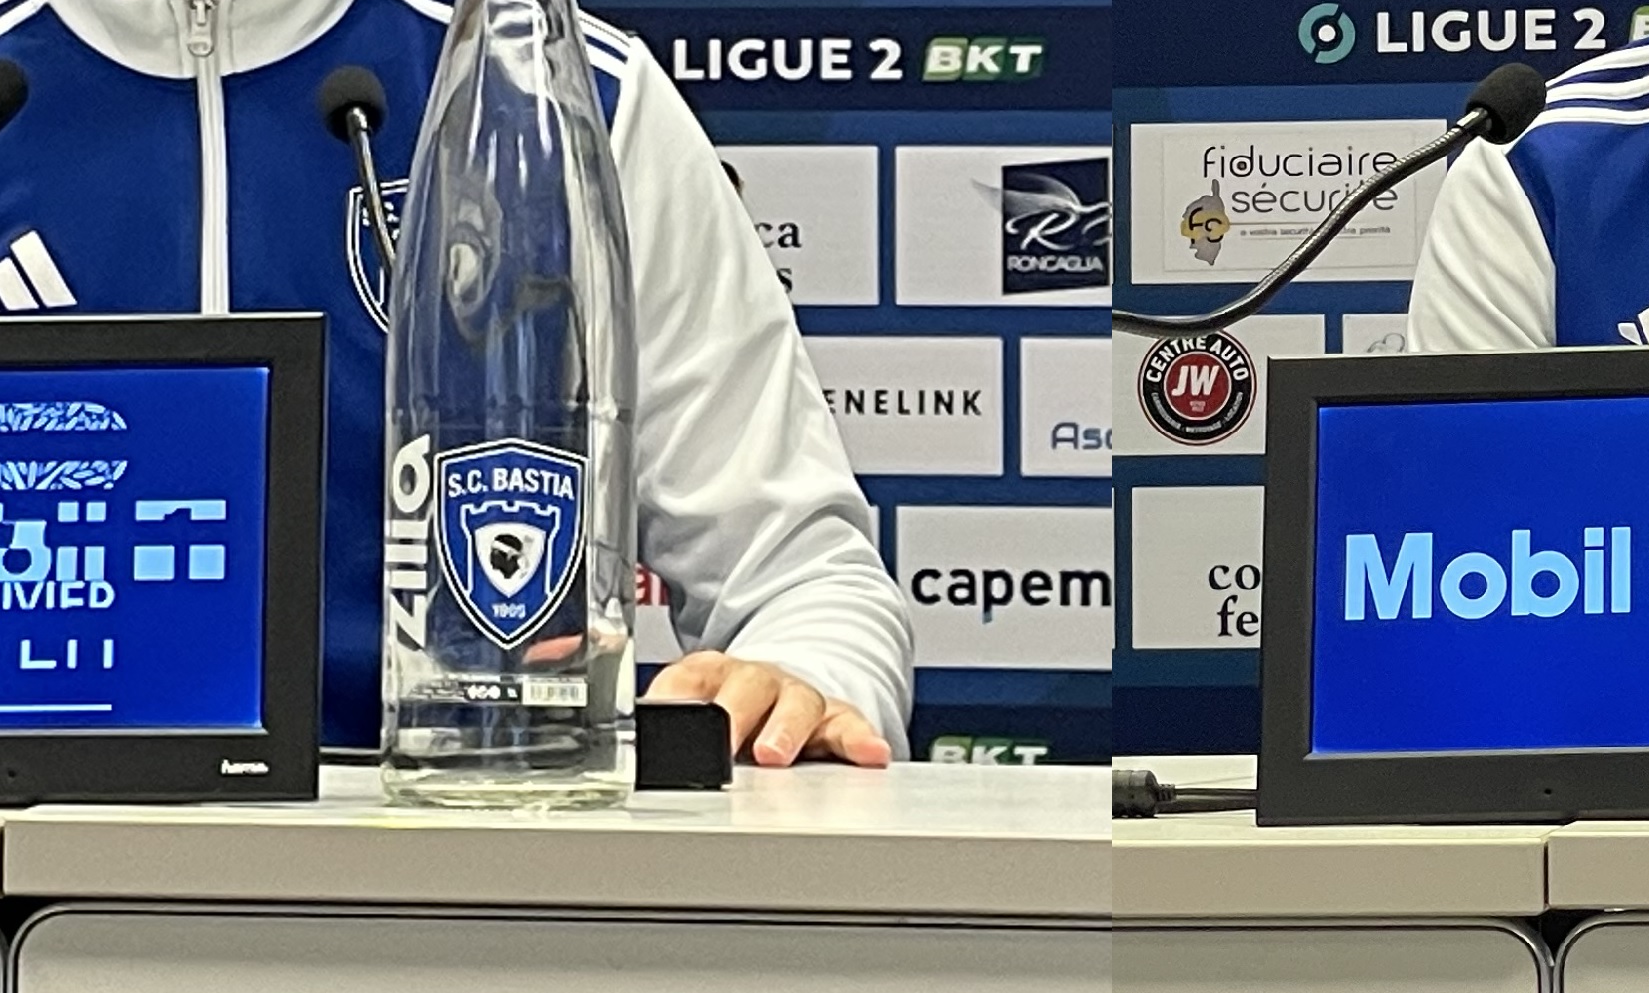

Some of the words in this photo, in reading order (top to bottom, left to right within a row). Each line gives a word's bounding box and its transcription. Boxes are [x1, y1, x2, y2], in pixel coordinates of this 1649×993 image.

[1376, 10, 1556, 54] LIGUE
[1574, 10, 1606, 50] 2
[674, 38, 854, 81] LIGUE
[870, 38, 904, 80] 2
[926, 44, 1043, 74] BKT
[1202, 145, 1398, 178] fiduciaire
[1007, 255, 1103, 273] RONCAGLIA
[1210, 339, 1249, 380] AUTO
[1171, 365, 1220, 396] JW
[448, 472, 488, 498] S.C.
[493, 467, 575, 501] BASTIA
[1344, 526, 1632, 622] Mobil
